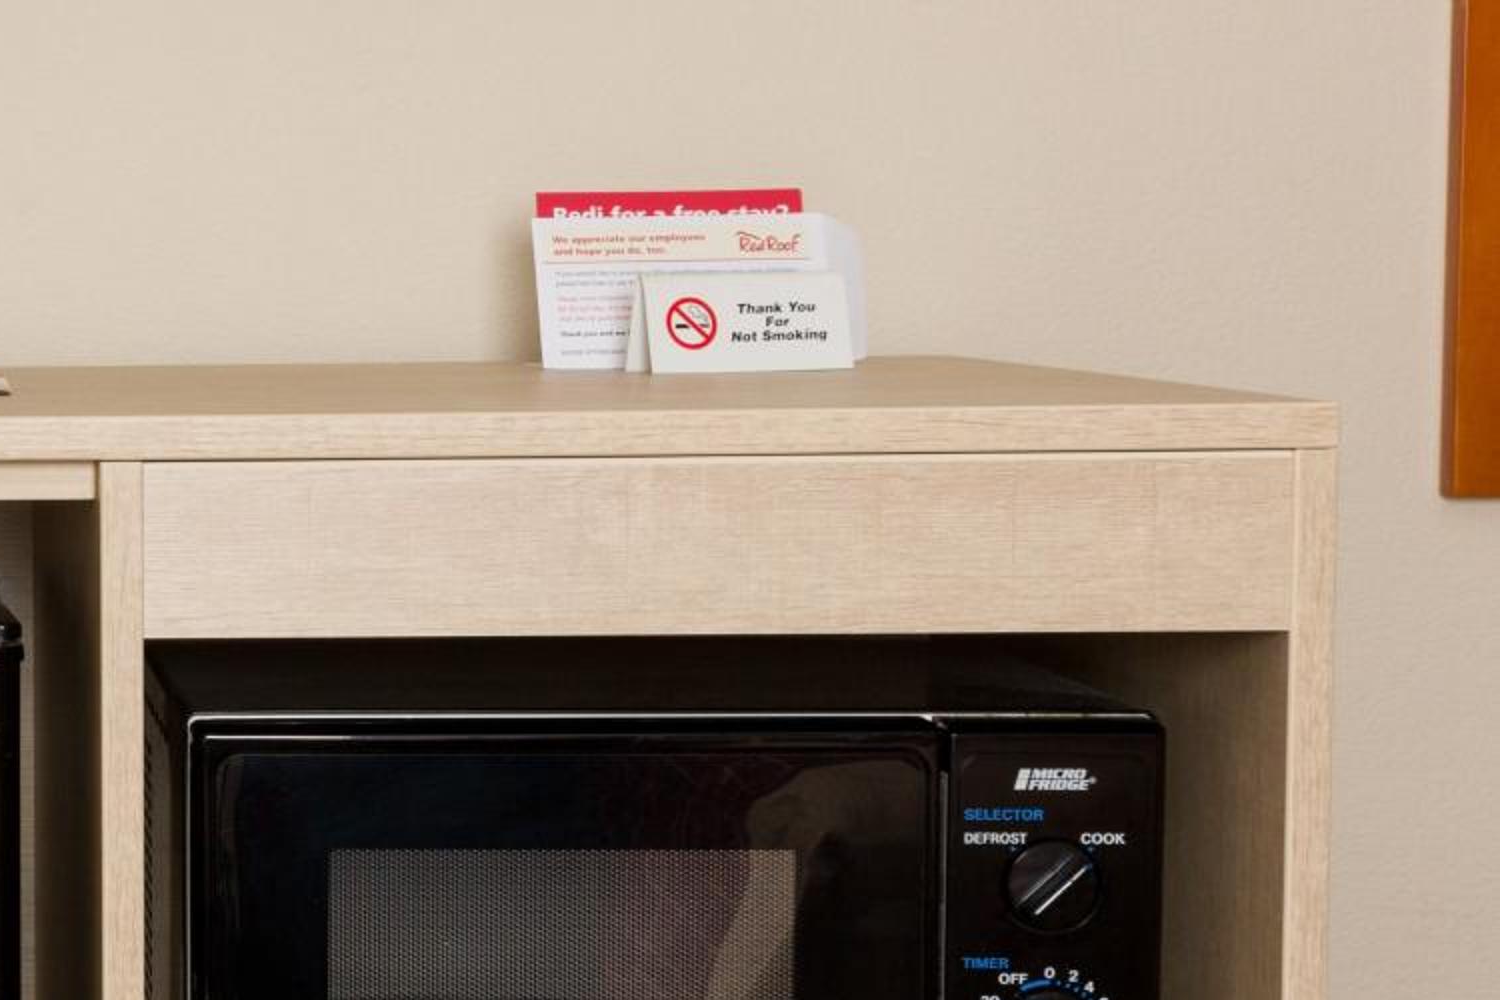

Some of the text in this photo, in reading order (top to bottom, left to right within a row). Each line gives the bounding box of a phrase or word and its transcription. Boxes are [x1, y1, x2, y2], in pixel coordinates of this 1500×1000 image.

[737, 301, 815, 314] Thank You
[765, 315, 790, 327] For
[731, 329, 828, 342] Not Smoking
[1028, 767, 1088, 780] MICRO
[1027, 779, 1090, 791] FRIDGE
[963, 808, 1045, 822] SELECTOR
[963, 832, 1126, 845] DEFROST COOK
[962, 957, 1010, 969] TIMER
[1044, 966, 1056, 979] 0
[1068, 970, 1080, 982] 2
[998, 973, 1028, 986] OFF
[1083, 981, 1095, 993] 4
